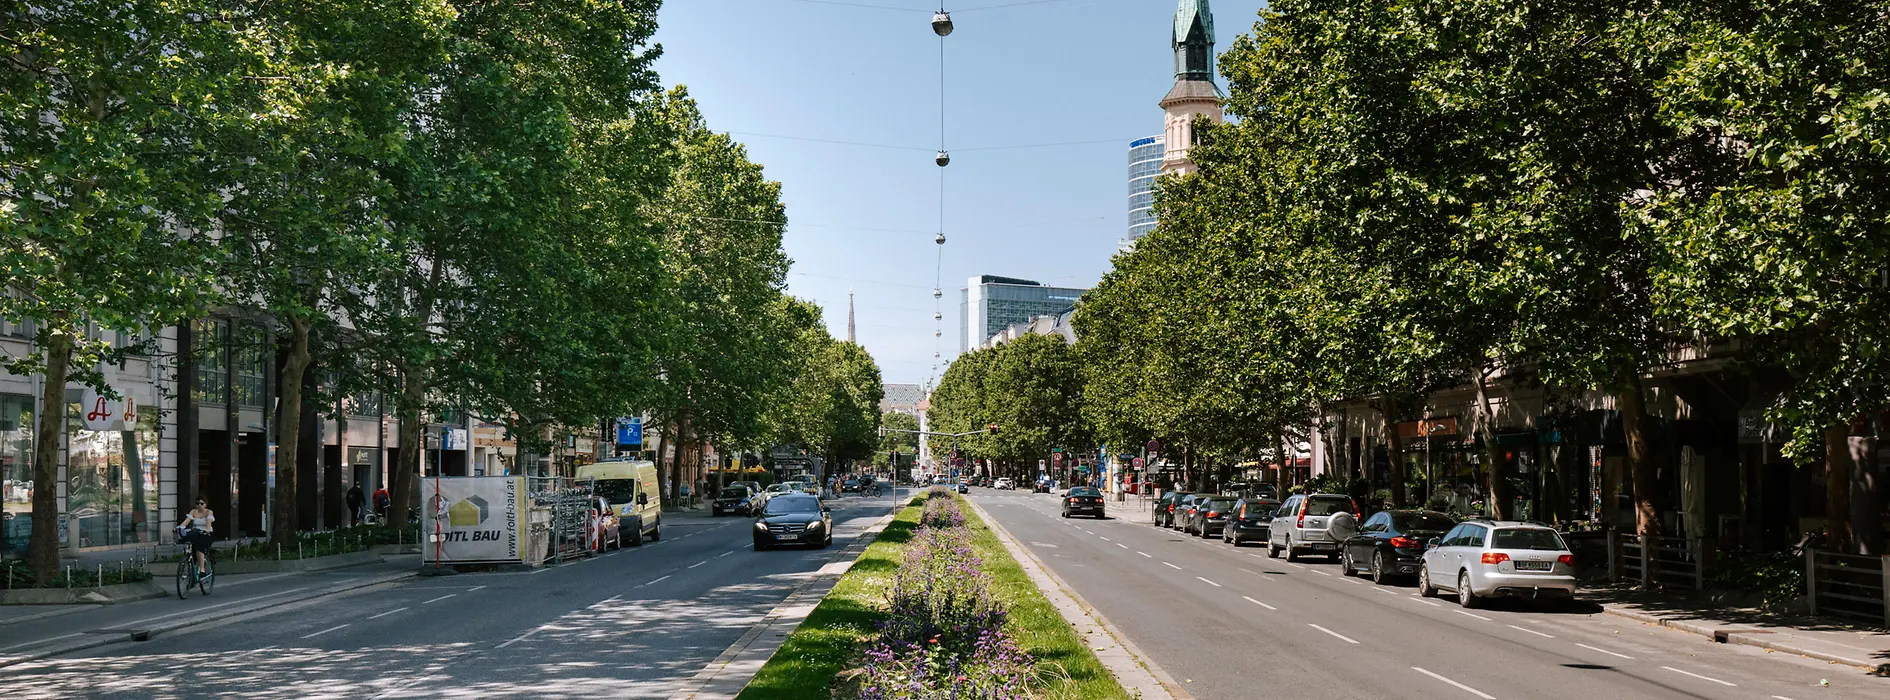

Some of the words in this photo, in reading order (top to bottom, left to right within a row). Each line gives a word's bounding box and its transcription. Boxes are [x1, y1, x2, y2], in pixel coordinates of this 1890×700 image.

[87, 396, 112, 421] A
[124, 397, 135, 422] A
[627, 427, 634, 437] P
[507, 480, 516, 557] www.foitl-bau.at
[472, 530, 501, 542] BAU
